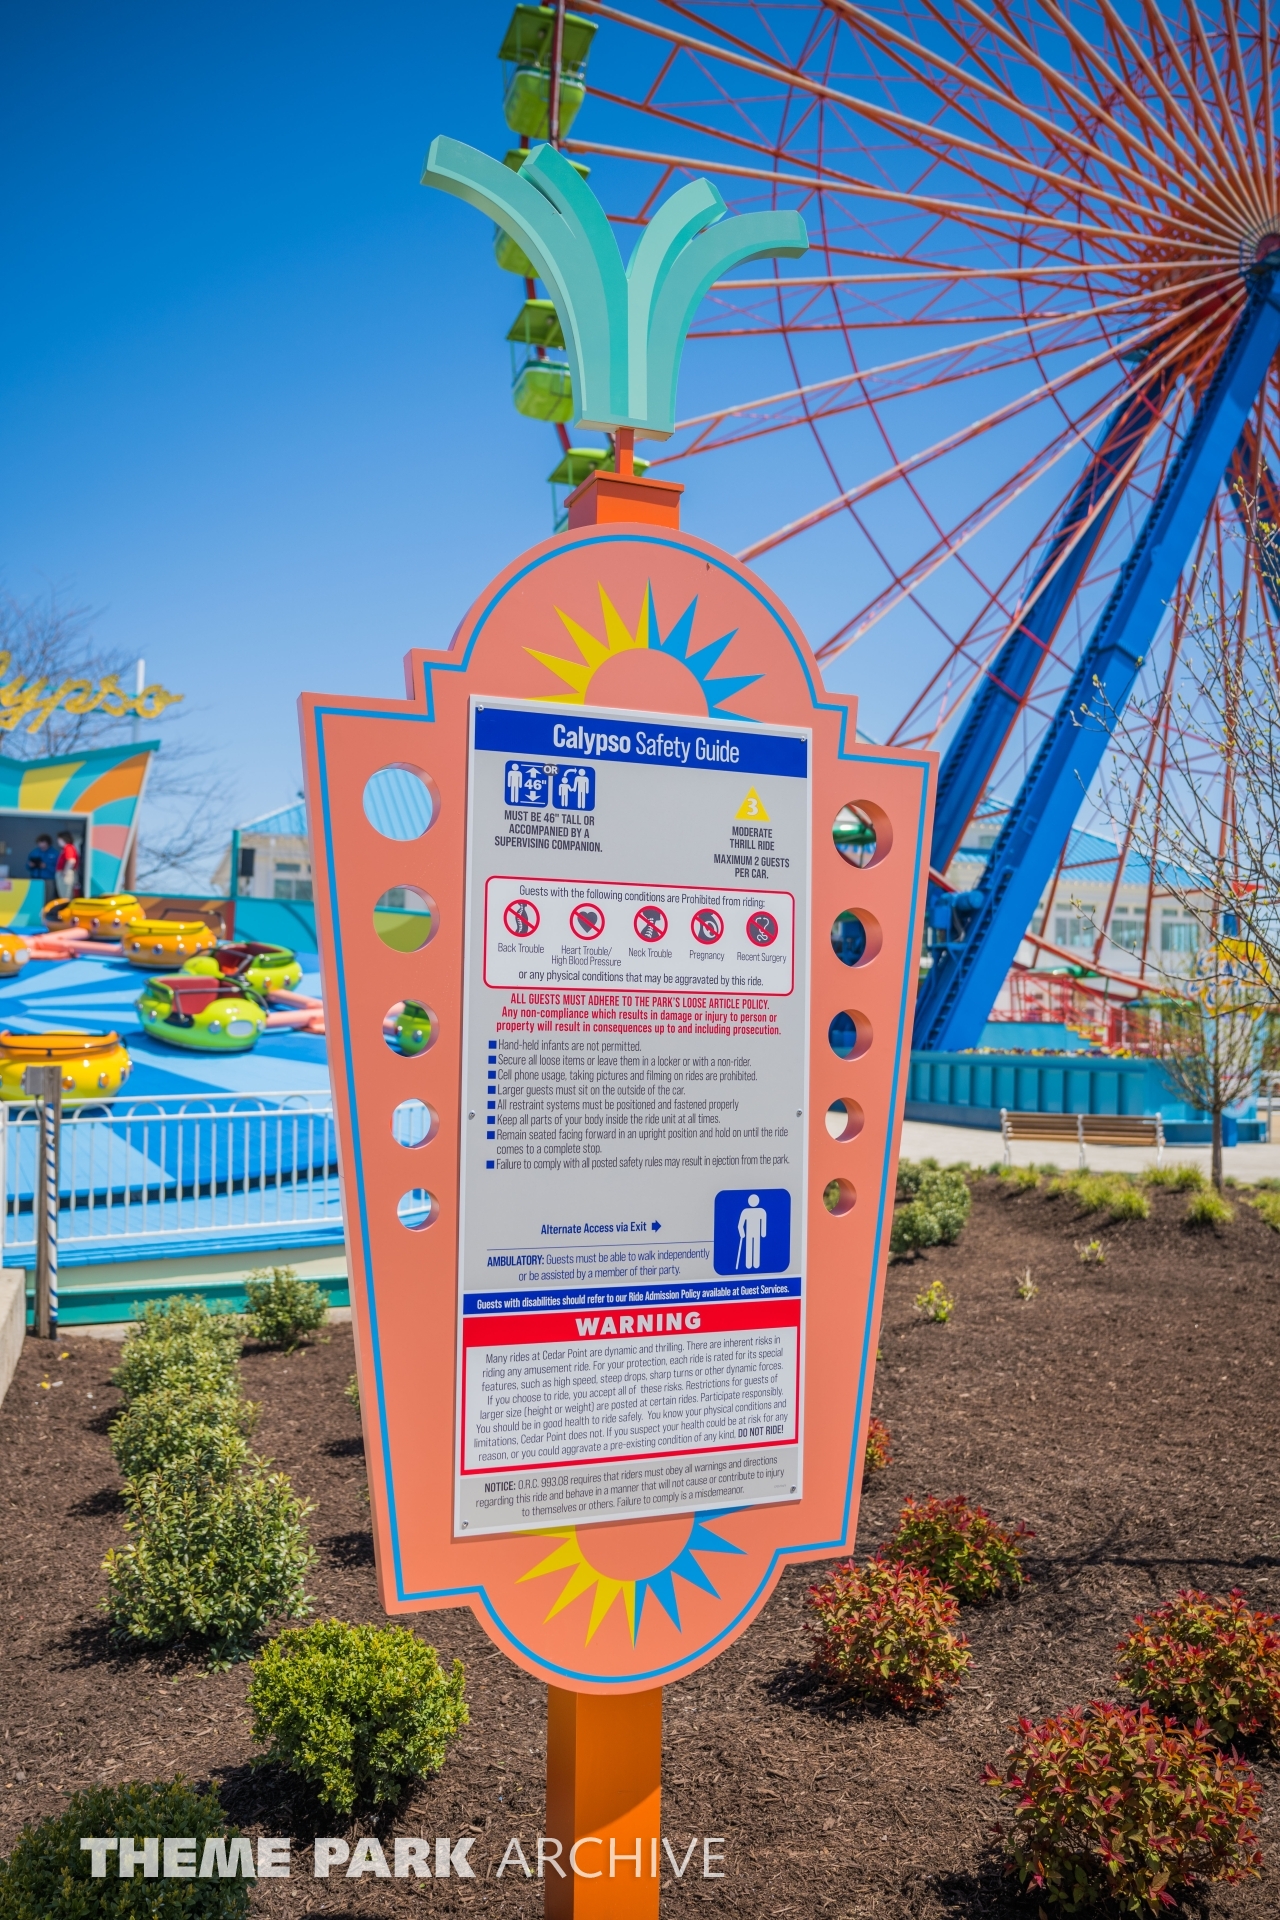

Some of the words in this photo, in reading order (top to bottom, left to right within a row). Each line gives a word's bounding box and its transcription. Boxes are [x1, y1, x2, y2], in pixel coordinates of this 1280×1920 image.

[553, 723, 631, 756] Calypso
[635, 731, 691, 763] Safety
[695, 736, 739, 763] Guide
[543, 765, 558, 775] OR
[523, 778, 547, 791] 46"
[746, 797, 759, 816] 3
[504, 809, 528, 821] MUST
[530, 811, 541, 822] BE
[543, 812, 559, 823] 46"
[561, 813, 581, 825] TALL
[583, 815, 594, 826] OR
[508, 823, 569, 837] ACCOMPANIED
[570, 827, 582, 838] BY
[583, 828, 590, 838] A
[731, 825, 772, 838] MODERATE
[494, 835, 549, 849] SUPERVISING
[551, 839, 602, 852] COMPANION.
[729, 838, 756, 849] THRILL
[757, 840, 774, 851] RIDE
[713, 853, 752, 865] MAXIMUM
[754, 856, 759, 866] 2
[760, 856, 789, 868] GUESTS
[734, 867, 749, 877] PER
[751, 868, 768, 879] CAR.
[519, 884, 548, 896] Guests
[550, 886, 568, 897] with
[570, 887, 584, 898] the
[586, 888, 622, 902] following
[624, 891, 665, 902] conditions
[666, 894, 679, 903] are
[681, 893, 720, 905] Prohibited
[722, 895, 740, 906] from
[742, 896, 765, 909] riding:
[497, 942, 516, 952] Back
[518, 942, 544, 953] Trouble
[561, 944, 581, 955] Heart
[582, 945, 612, 956] Trouble/
[628, 947, 646, 957] Neck
[647, 947, 672, 958] Trouble
[551, 954, 567, 966] High
[568, 955, 588, 965] Blood
[589, 956, 621, 966] Pressure
[689, 949, 724, 962] Pregnancy
[736, 951, 760, 961] Recent
[761, 952, 786, 964] Surgery
[518, 970, 527, 979] or
[529, 971, 544, 981] any
[546, 969, 580, 982] physical
[581, 971, 623, 982] conditions
[625, 972, 642, 982] that
[644, 974, 662, 985] may
[663, 972, 673, 983] be
[674, 974, 718, 986] aggravated
[720, 974, 729, 987] by
[731, 975, 745, 985] this
[747, 975, 763, 986] ride.
[510, 992, 526, 1004] ALL
[528, 993, 560, 1005] GUESTS
[562, 994, 586, 1005] MUST
[587, 994, 619, 1006] ADHERE
[621, 995, 632, 1006] TO
[634, 995, 650, 1007] THE
[651, 996, 680, 1008] PARK'S
[682, 997, 706, 1008] LOOSE
[708, 997, 740, 1009] ARTICLE
[741, 998, 769, 1010] POLICY.
[498, 1038, 539, 1050] Hand-held
[541, 1039, 569, 1050] infants
[570, 1042, 584, 1051] are
[586, 1040, 599, 1051] not
[601, 1040, 641, 1053] permitted.
[497, 1083, 524, 1097] Larger
[525, 1084, 553, 1097] guests
[555, 1084, 576, 1095] must
[578, 1084, 588, 1095] sit
[590, 1086, 600, 1095] on
[602, 1084, 615, 1095] the
[616, 1084, 645, 1095] outside
[647, 1084, 655, 1095] of
[657, 1084, 670, 1095] the
[672, 1086, 685, 1095] car.
[496, 1145, 523, 1154] comes
[526, 1143, 534, 1154] to
[536, 1145, 541, 1154] a
[543, 1142, 580, 1155] complete
[582, 1143, 601, 1155] stop.
[540, 1224, 581, 1234] Alternate
[583, 1222, 614, 1233] Access
[615, 1221, 628, 1232] via
[630, 1221, 646, 1232] Exit
[486, 1254, 544, 1267] AMBULATORY:
[546, 1254, 574, 1264] Guests
[575, 1253, 596, 1263] must
[598, 1252, 608, 1262] be
[609, 1251, 626, 1262] able
[627, 1252, 636, 1261] to
[637, 1250, 655, 1260] walk
[657, 1248, 709, 1261] independently
[476, 1299, 502, 1309] Guests
[503, 1297, 520, 1308] with
[521, 1295, 561, 1307] disabilities
[561, 1294, 586, 1305] should
[586, 1293, 605, 1304] refer
[606, 1293, 614, 1303] to
[615, 1294, 627, 1302] our
[628, 1291, 644, 1302] Ride
[644, 1289, 679, 1301] Admission
[680, 1288, 701, 1300] Policy
[701, 1286, 731, 1298] available
[731, 1286, 739, 1296] at
[740, 1285, 759, 1295] Guest
[760, 1284, 789, 1294] Services.
[575, 1311, 701, 1336] WARNING
[485, 1353, 507, 1364] Many
[509, 1351, 530, 1362] rides
[531, 1351, 540, 1361] at
[542, 1349, 565, 1360] Cedar
[567, 1348, 587, 1358] Point
[589, 1348, 602, 1357] are
[604, 1344, 637, 1357] dynamic
[638, 1343, 653, 1354] and
[655, 1342, 684, 1353] thrilling.
[686, 1340, 708, 1350] There
[709, 1340, 721, 1349] are
[723, 1337, 753, 1347] inherent
[755, 1335, 772, 1345] risks
[774, 1335, 780, 1344] in
[478, 1451, 508, 1461] reason,
[510, 1450, 519, 1458] or
[521, 1449, 536, 1460] you
[538, 1444, 560, 1456] could
[561, 1442, 601, 1456] aggravate
[610, 1437, 656, 1451] pre-existing
[657, 1434, 692, 1445] condition
[693, 1431, 702, 1442] of
[703, 1433, 717, 1442] any
[737, 1427, 748, 1438] DO
[749, 1426, 764, 1437] NOT
[765, 1424, 784, 1435] RIDE!
[521, 1507, 530, 1517] to
[531, 1502, 577, 1516] themselves
[578, 1502, 586, 1511] or
[588, 1499, 615, 1510] others.
[616, 1496, 641, 1506] Failure
[643, 1495, 651, 1504] to
[652, 1491, 679, 1503] comply
[680, 1490, 687, 1500] is
[688, 1491, 693, 1499] a
[694, 1486, 744, 1498] misdemeanor.
